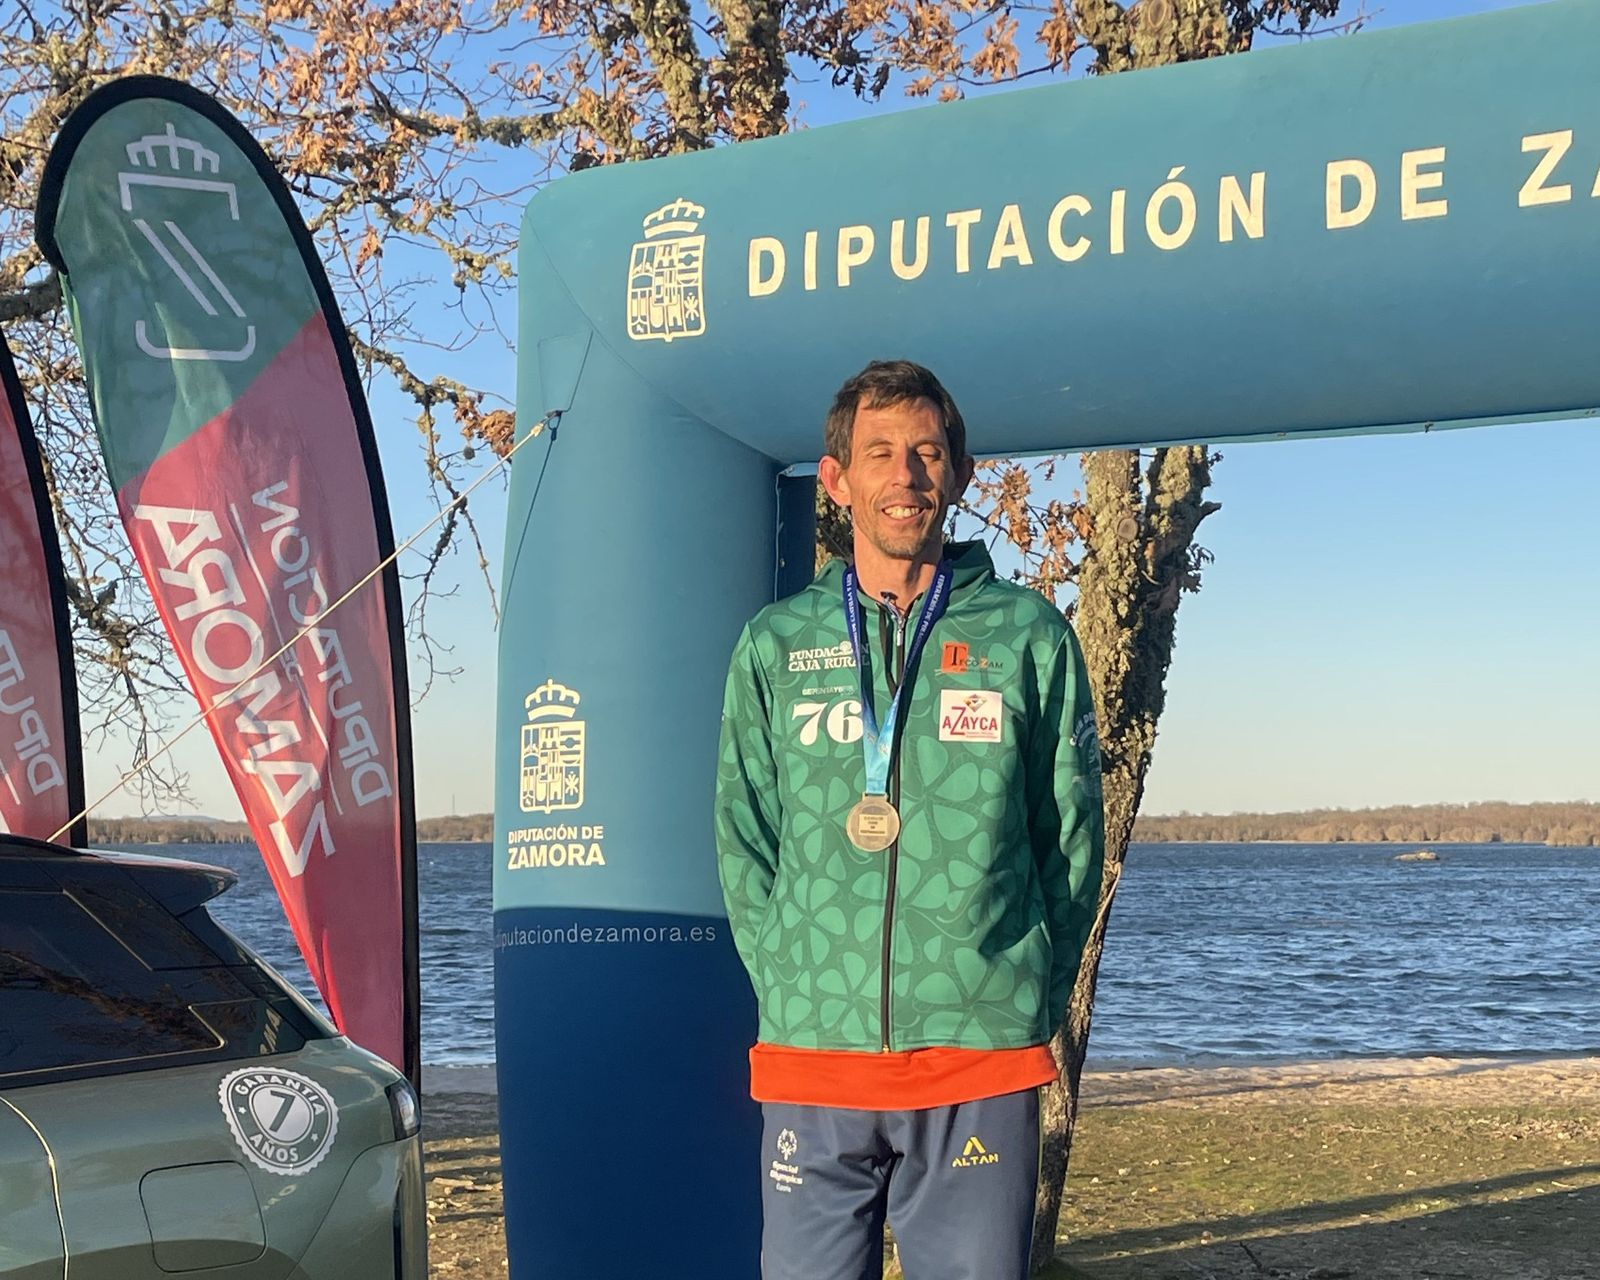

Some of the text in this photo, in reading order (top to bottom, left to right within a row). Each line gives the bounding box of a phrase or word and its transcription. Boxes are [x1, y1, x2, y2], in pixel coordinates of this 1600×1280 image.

[748, 129, 1600, 297] DIPUTACIÓN DE Z
[788, 643, 869, 662] FUNDACN
[788, 659, 821, 672] CAJA
[792, 700, 864, 746] 76
[942, 706, 998, 735] AZAYCA
[508, 824, 604, 844] DIPUTACIÓN DE
[507, 843, 606, 870] ZAMORA
[496, 922, 717, 953] putaciondezamora.es
[234, 1074, 326, 1116] GARANTIA
[269, 1089, 298, 1133] 7
[250, 1133, 299, 1162] AÑOS
[952, 1153, 999, 1168] ALTAN
